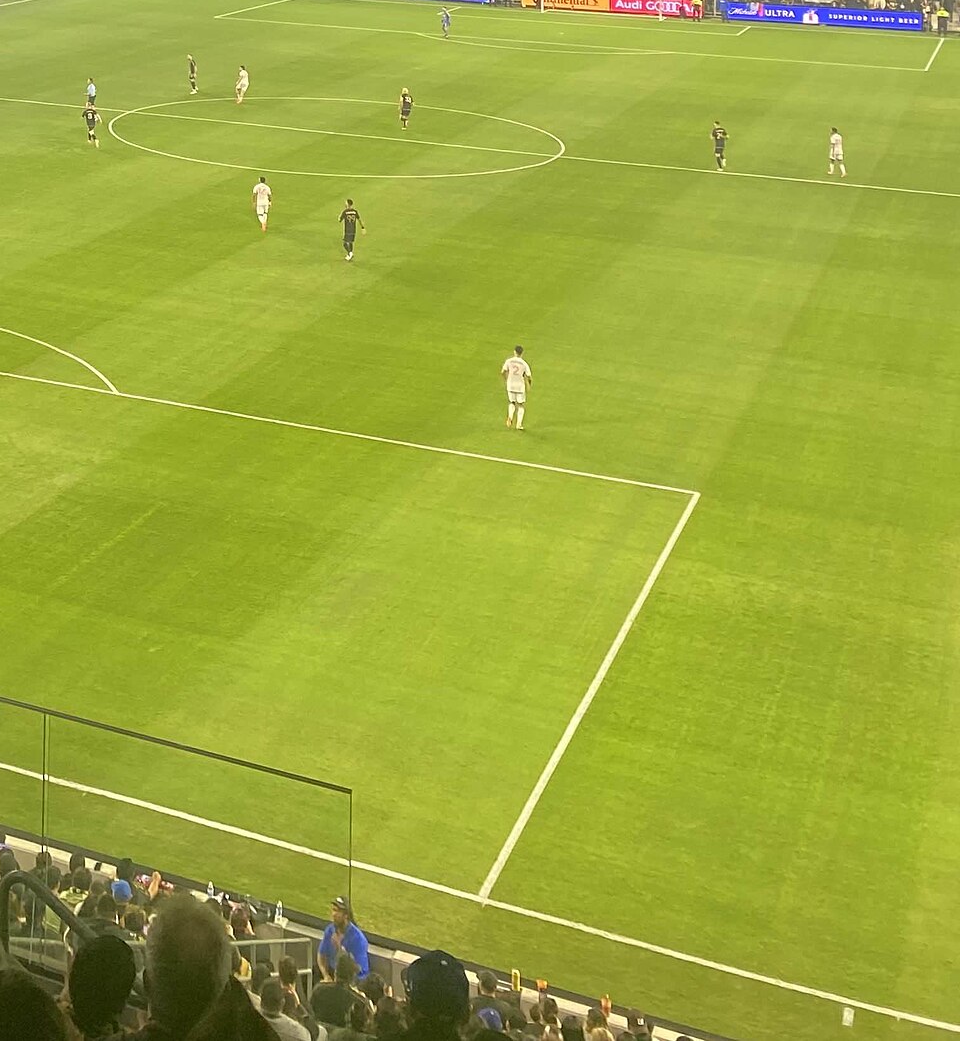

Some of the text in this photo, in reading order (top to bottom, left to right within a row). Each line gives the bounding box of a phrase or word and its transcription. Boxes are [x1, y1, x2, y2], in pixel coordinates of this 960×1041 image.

[615, 0, 642, 10] Audi
[764, 9, 796, 18] ULTRA
[828, 13, 868, 22] SUPERIOR
[512, 365, 520, 376] 2
